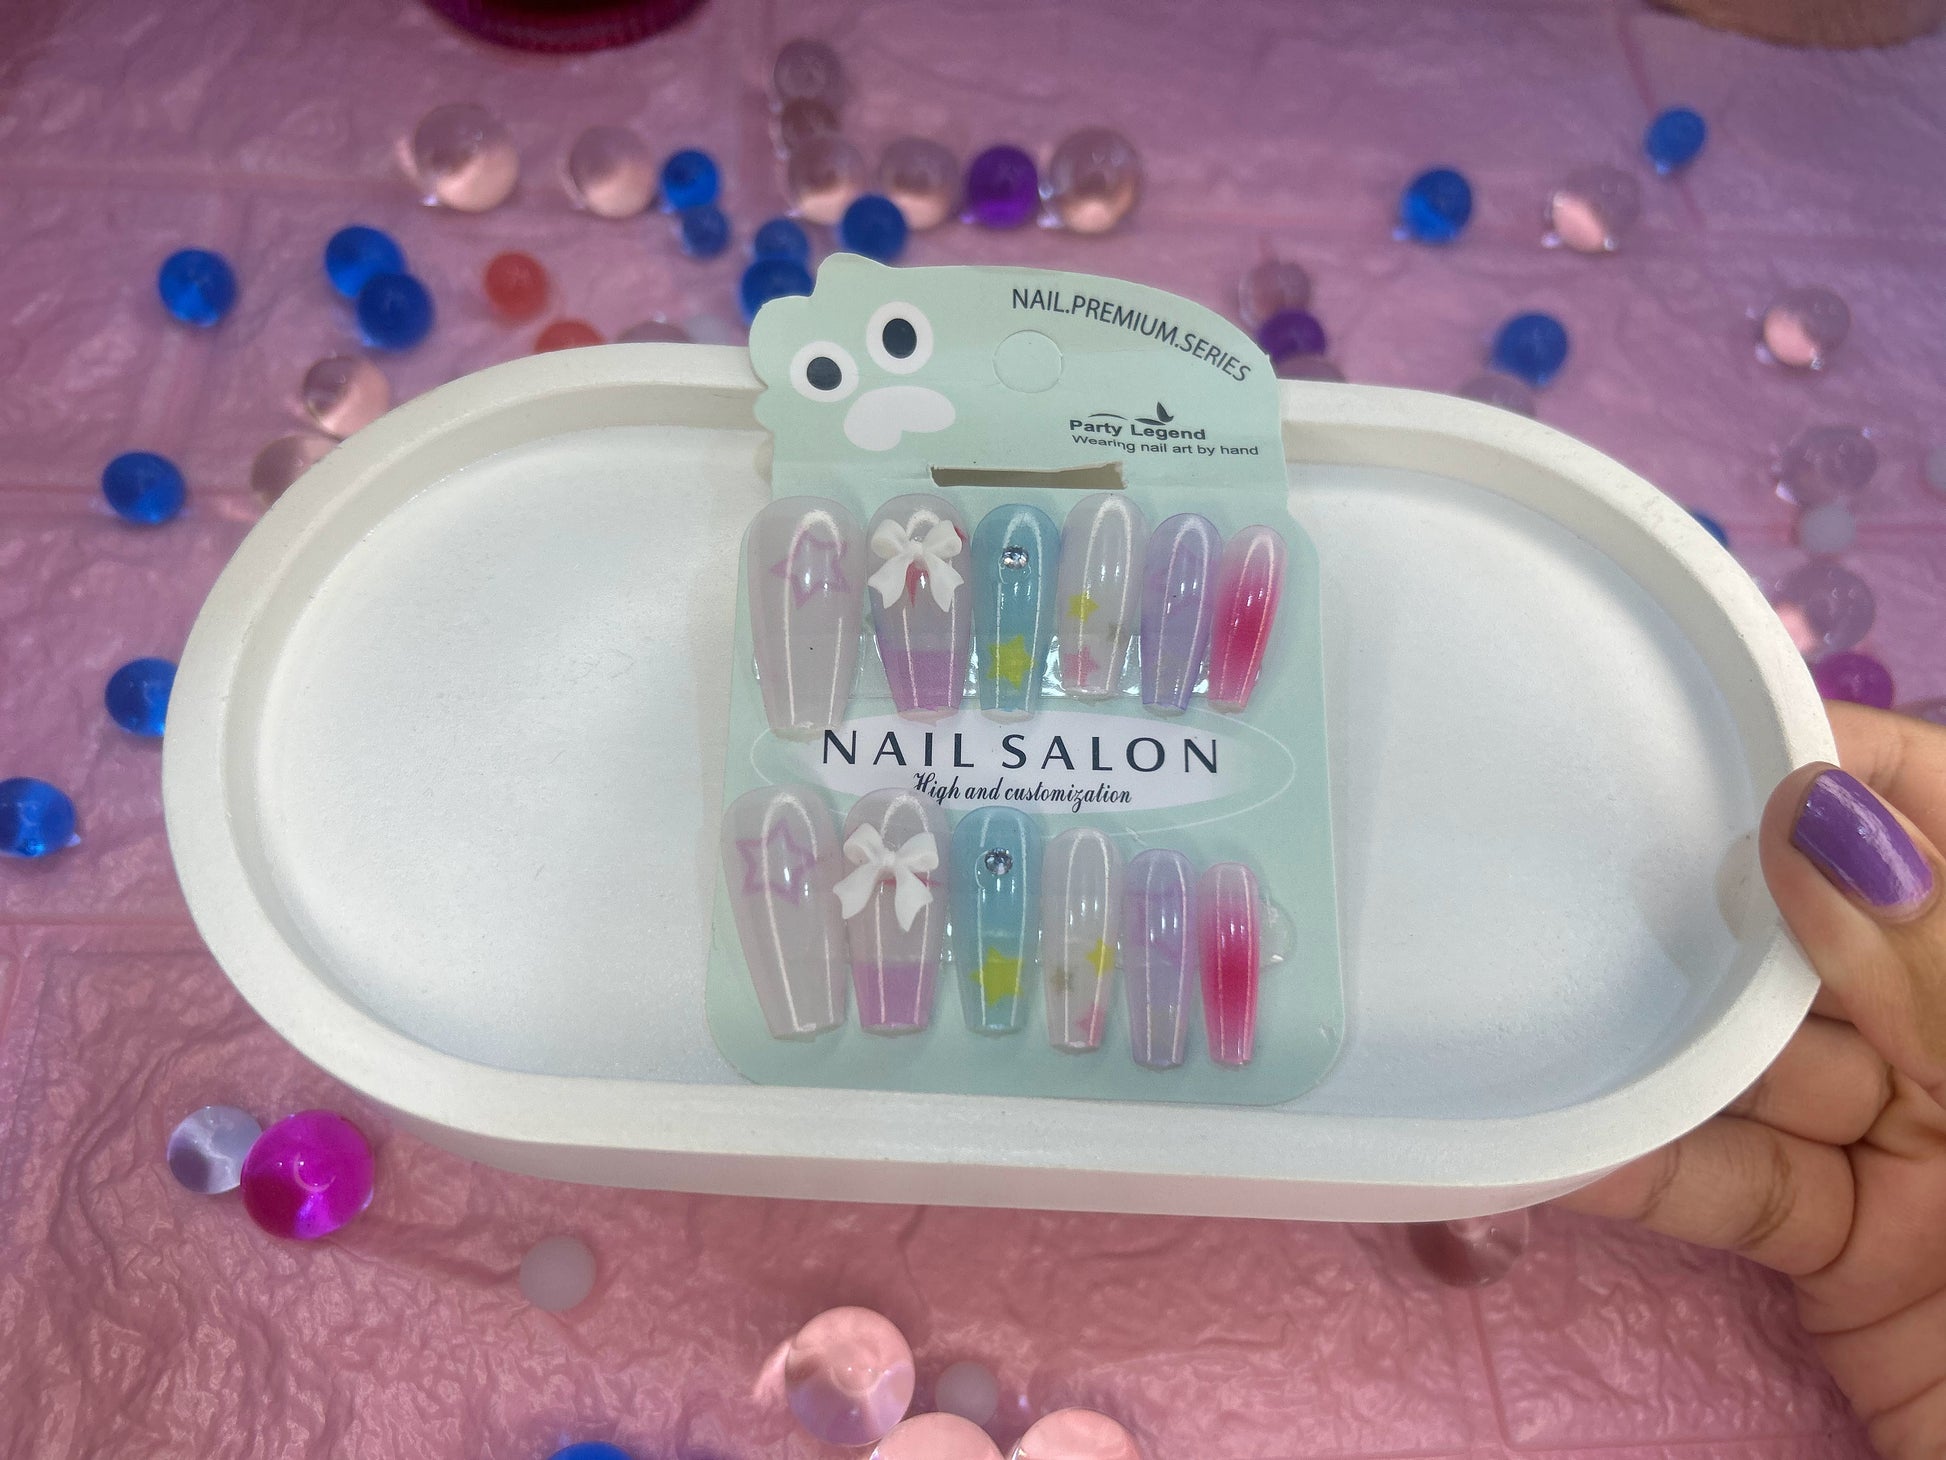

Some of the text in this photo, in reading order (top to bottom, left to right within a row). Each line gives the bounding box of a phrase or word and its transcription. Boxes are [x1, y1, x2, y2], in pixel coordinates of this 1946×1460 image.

[1012, 288, 1252, 382] NAIL.PREMIUM.SERIES
[1069, 419, 1206, 441] Party Legend
[1072, 434, 1259, 457] Wearing nail art by hand
[822, 729, 1218, 774] NAIL SALON
[913, 772, 1133, 814] High and customization
